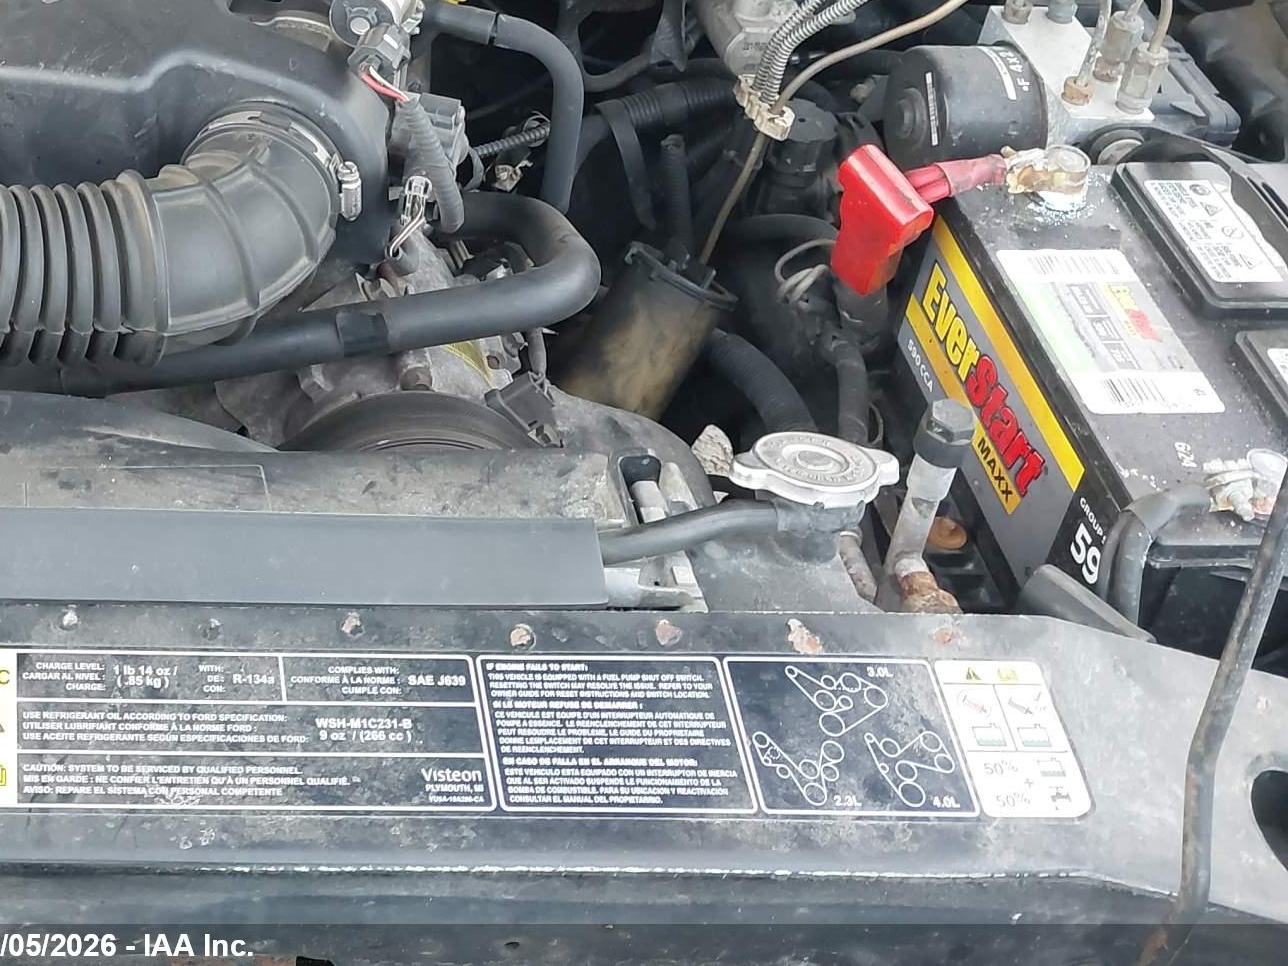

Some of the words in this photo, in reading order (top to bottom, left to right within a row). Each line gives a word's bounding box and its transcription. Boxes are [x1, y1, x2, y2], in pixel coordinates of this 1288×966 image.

[920, 364, 933, 392] CCA
[920, 263, 1045, 497] EverStart
[977, 438, 1013, 502] MAXX
[1079, 497, 1104, 538] GROUP
[1070, 523, 1102, 585] 59
[113, 664, 119, 675] 1
[123, 665, 135, 675] lb
[138, 665, 153, 675] 14
[155, 667, 170, 675] oz
[867, 667, 893, 677] 3.0L
[232, 674, 274, 684] R-134a
[407, 674, 434, 685] SAE
[436, 674, 466, 685] J639
[22, 711, 41, 719] USE
[42, 711, 104, 720] REFRIGERANT
[106, 712, 121, 720] OIL
[122, 712, 176, 720] ACCORDING
[177, 712, 190, 720] TO
[192, 712, 217, 721] FORD
[219, 713, 287, 721] SPECIFICATION:
[22, 722, 62, 730] UTILISER
[64, 722, 116, 731] LUBRIFIANT
[118, 723, 168, 731] CONFORME
[179, 723, 191, 731] LA
[193, 723, 224, 732] NORME
[227, 724, 252, 732] FORD
[314, 717, 412, 729] WSH-M1C231-B
[22, 732, 41, 740] USE
[42, 732, 74, 741] ACEITE
[76, 733, 145, 741] REFRIGERANTE
[180, 734, 265, 742] ESPECIFICACIONES
[267, 734, 279, 742] DE
[318, 730, 327, 740] 9
[330, 732, 346, 740] oz
[22, 763, 65, 772] CAUTION:
[67, 764, 104, 772] SYSTEM
[106, 764, 119, 772] TO
[120, 764, 133, 772] BE
[135, 764, 180, 773] SERVICED
[182, 765, 193, 773] BY
[196, 765, 243, 773] QUALIFIED
[245, 765, 302, 774] PERSONNEL.
[984, 759, 1020, 775] 50%
[22, 774, 39, 782] MIS
[56, 774, 88, 783] GARDE
[95, 775, 108, 783] NE
[109, 775, 148, 783] CONFIER
[235, 776, 248, 784] UN
[250, 776, 304, 784] PERSONNEL
[420, 768, 482, 782] Visteon
[22, 786, 53, 794] AVISO:
[55, 786, 91, 794] REPARE
[93, 786, 105, 794] EL
[107, 786, 146, 794] SISTEMA
[149, 786, 168, 795] CON
[170, 787, 219, 795] PERSONAL
[221, 787, 282, 795] COMPETENTE
[424, 783, 472, 793] PLYMOUTH,
[834, 796, 862, 806] 2.3L
[933, 797, 960, 808] 4.0L
[995, 790, 1032, 808] 50%
